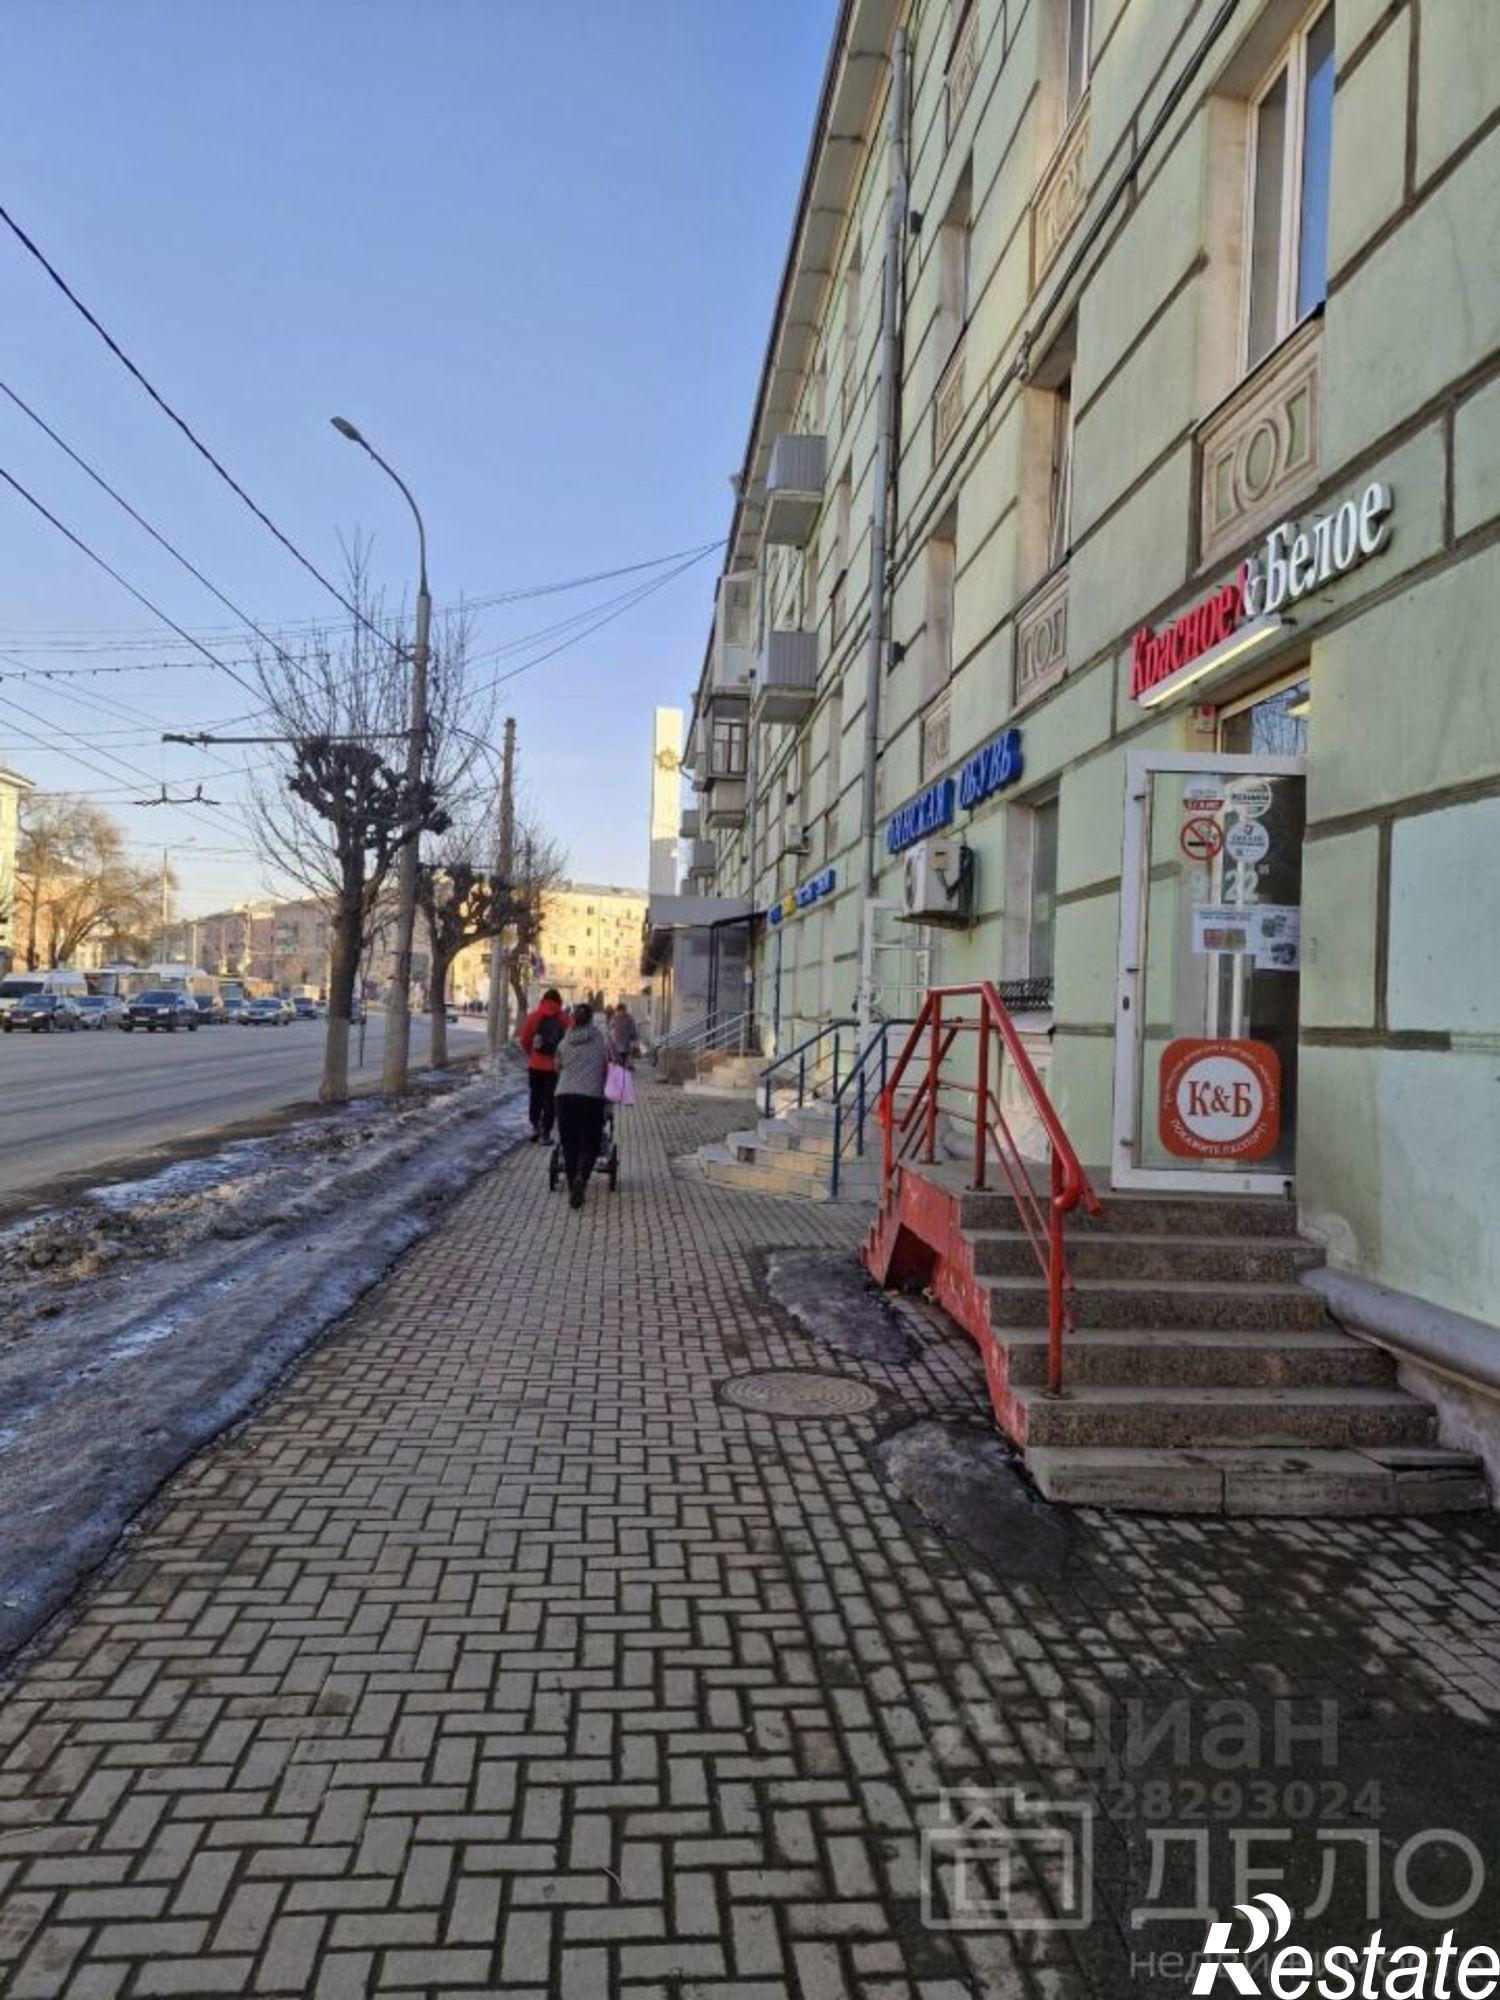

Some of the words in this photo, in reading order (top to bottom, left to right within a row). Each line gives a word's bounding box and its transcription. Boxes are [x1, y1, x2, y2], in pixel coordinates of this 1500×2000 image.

[1129, 585, 1233, 699] Красное
[1264, 482, 1391, 614] Белое
[1187, 1080, 1253, 1117] К&Б
